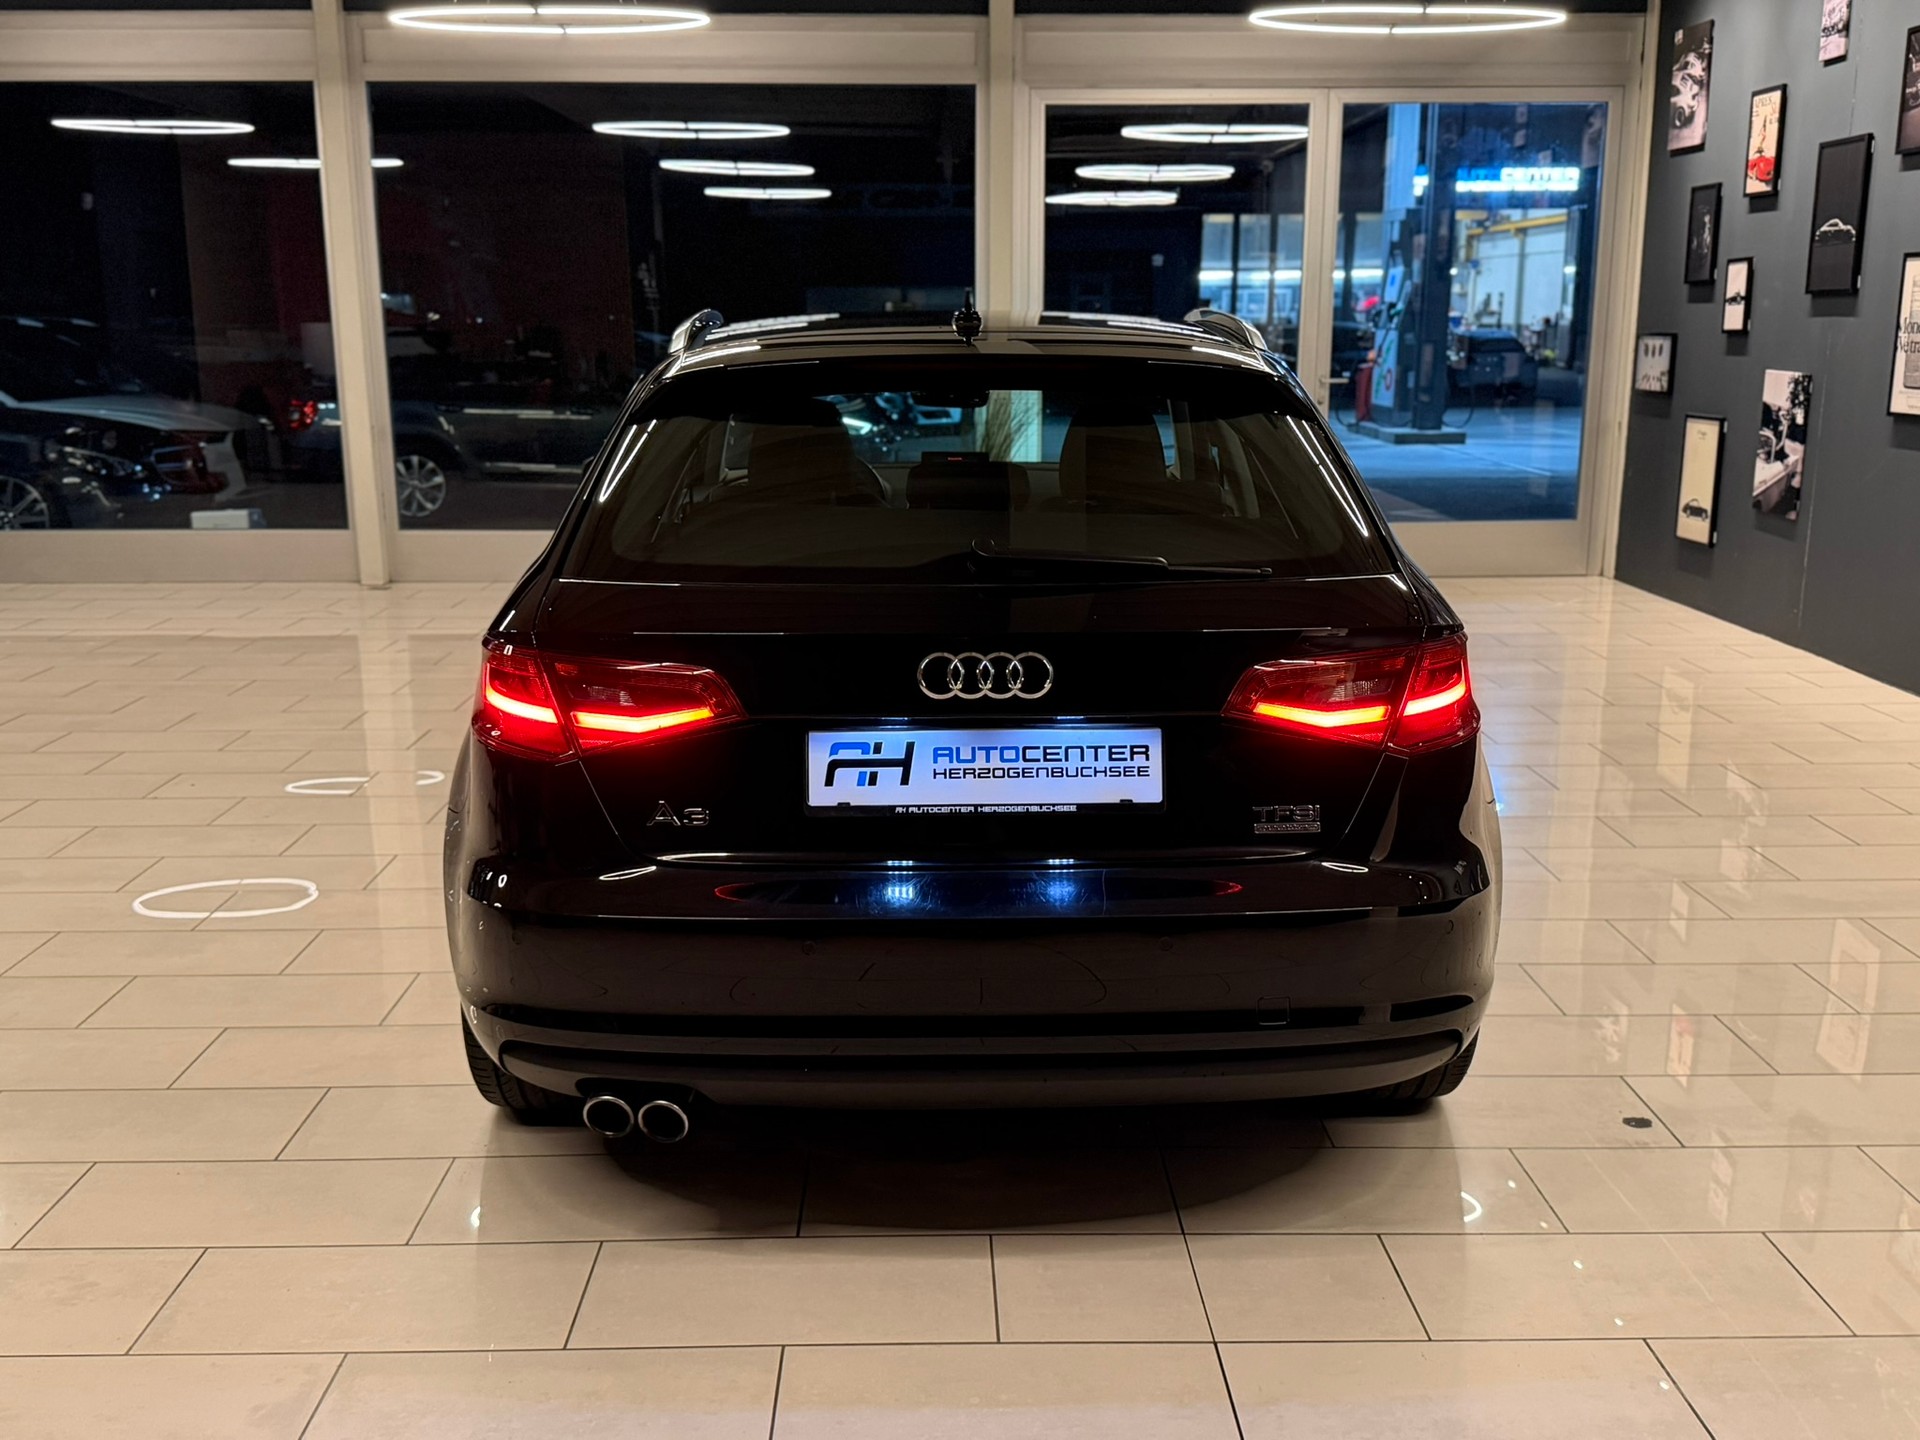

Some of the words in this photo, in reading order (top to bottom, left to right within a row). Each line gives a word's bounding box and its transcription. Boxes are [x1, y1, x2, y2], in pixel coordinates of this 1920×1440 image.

[932, 745, 1150, 763] AUTOCENTER
[932, 766, 1150, 779] HERZOGENBUCHSEE
[646, 800, 710, 826] A3
[908, 806, 975, 814] AUTOCENTER
[977, 804, 1078, 813] HERZOGENBUCHSEE
[1252, 804, 1321, 821] TFSI
